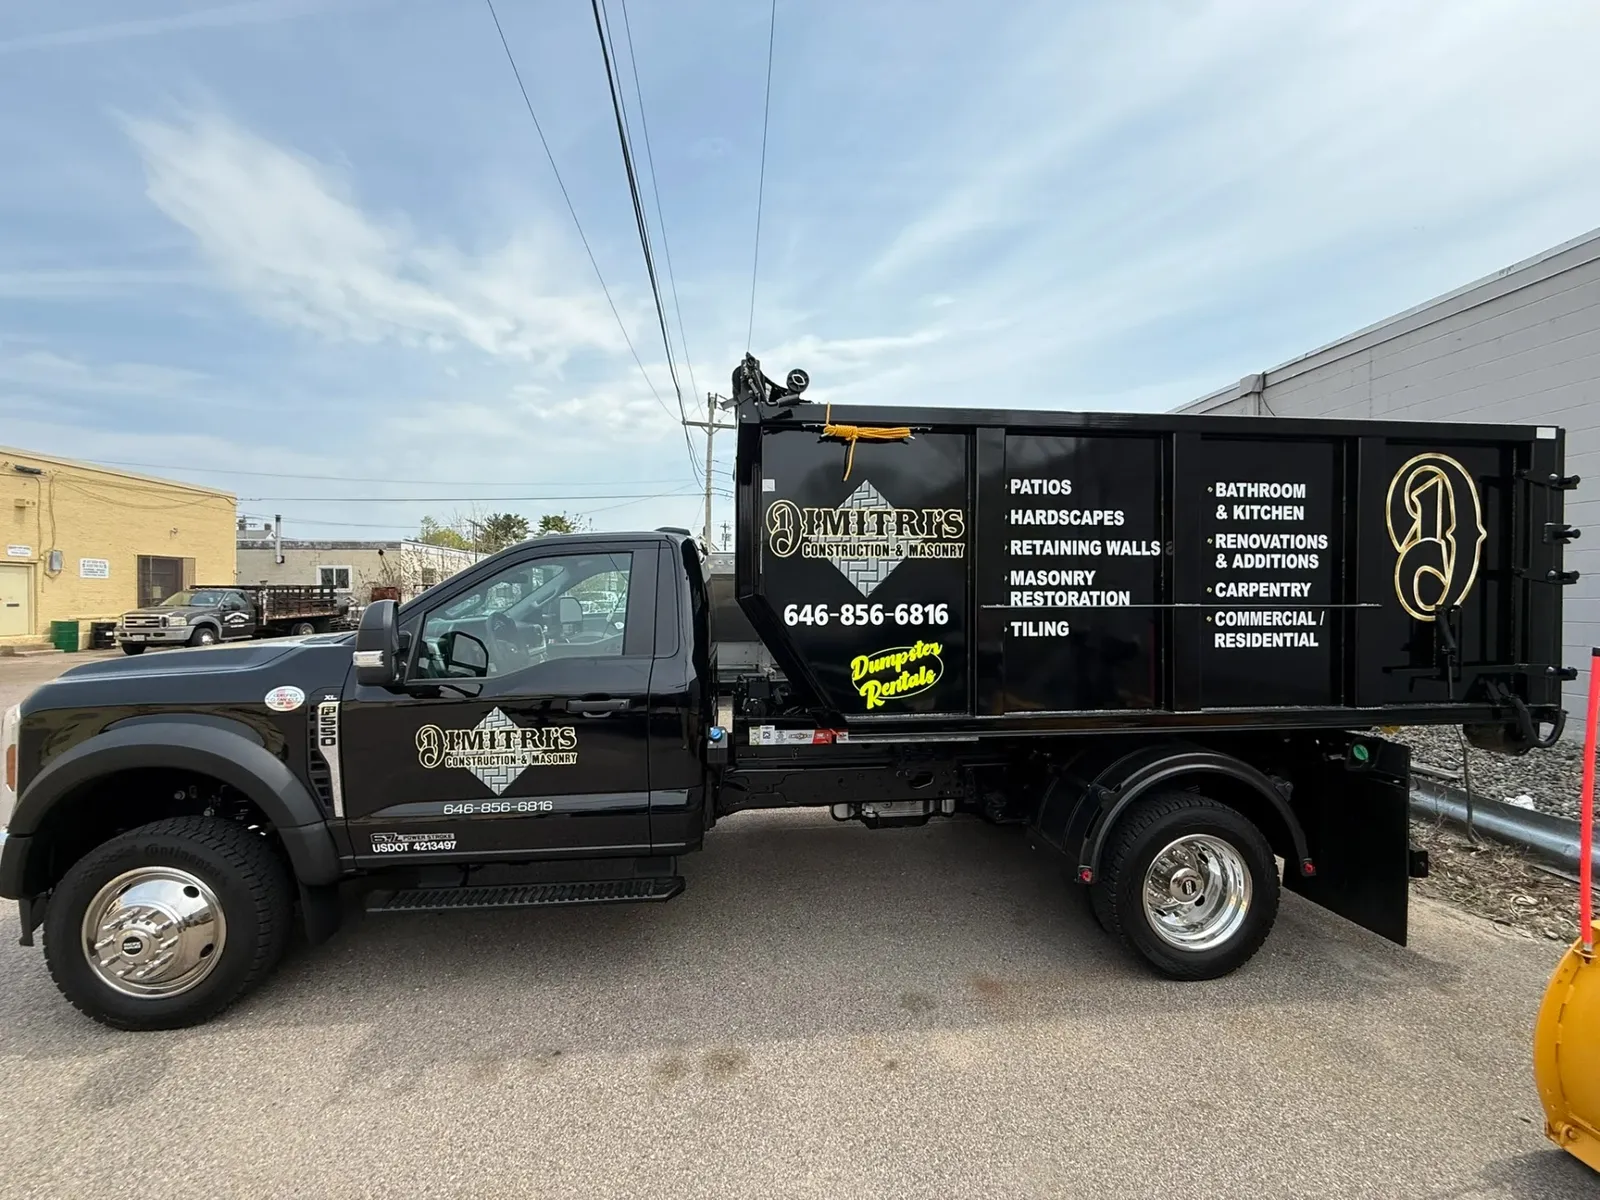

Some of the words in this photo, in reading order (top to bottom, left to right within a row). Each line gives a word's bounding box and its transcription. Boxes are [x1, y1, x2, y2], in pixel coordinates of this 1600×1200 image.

[1010, 478, 1072, 496] PATIOS
[1215, 481, 1306, 499] BATHROOM
[1010, 509, 1125, 526] HARDSCAPES
[1215, 504, 1229, 520] &
[1233, 504, 1305, 521] KITCHEN
[766, 499, 965, 558] DIMITRI'S
[802, 542, 891, 558] CONSTRUCTION
[908, 543, 965, 558] MASONRY
[1010, 539, 1102, 556] RETAINING
[1105, 540, 1161, 556] WALLS
[1215, 533, 1329, 550] RENOVATIONS
[1215, 553, 1228, 569] &
[1231, 553, 1320, 570] ADDITIONS
[1010, 569, 1097, 586] MASONRY
[1010, 590, 1131, 605] RESTORATION
[1215, 582, 1312, 598] CARPENTRY
[783, 603, 949, 627] 646-856-6816
[1214, 610, 1317, 627] COMMERCIAL
[1010, 620, 1070, 637] TILING
[1214, 632, 1319, 648] RESIDENTIAL
[850, 639, 943, 681] Dumpster
[859, 665, 936, 710] Rentals
[415, 724, 577, 769] DIMITRI'S
[445, 755, 517, 768] CONSTRUCTION
[531, 752, 578, 765] MASONRY
[444, 798, 554, 815] 646-856-6816
[371, 842, 410, 853] USDOT
[413, 840, 457, 851] 4213497
